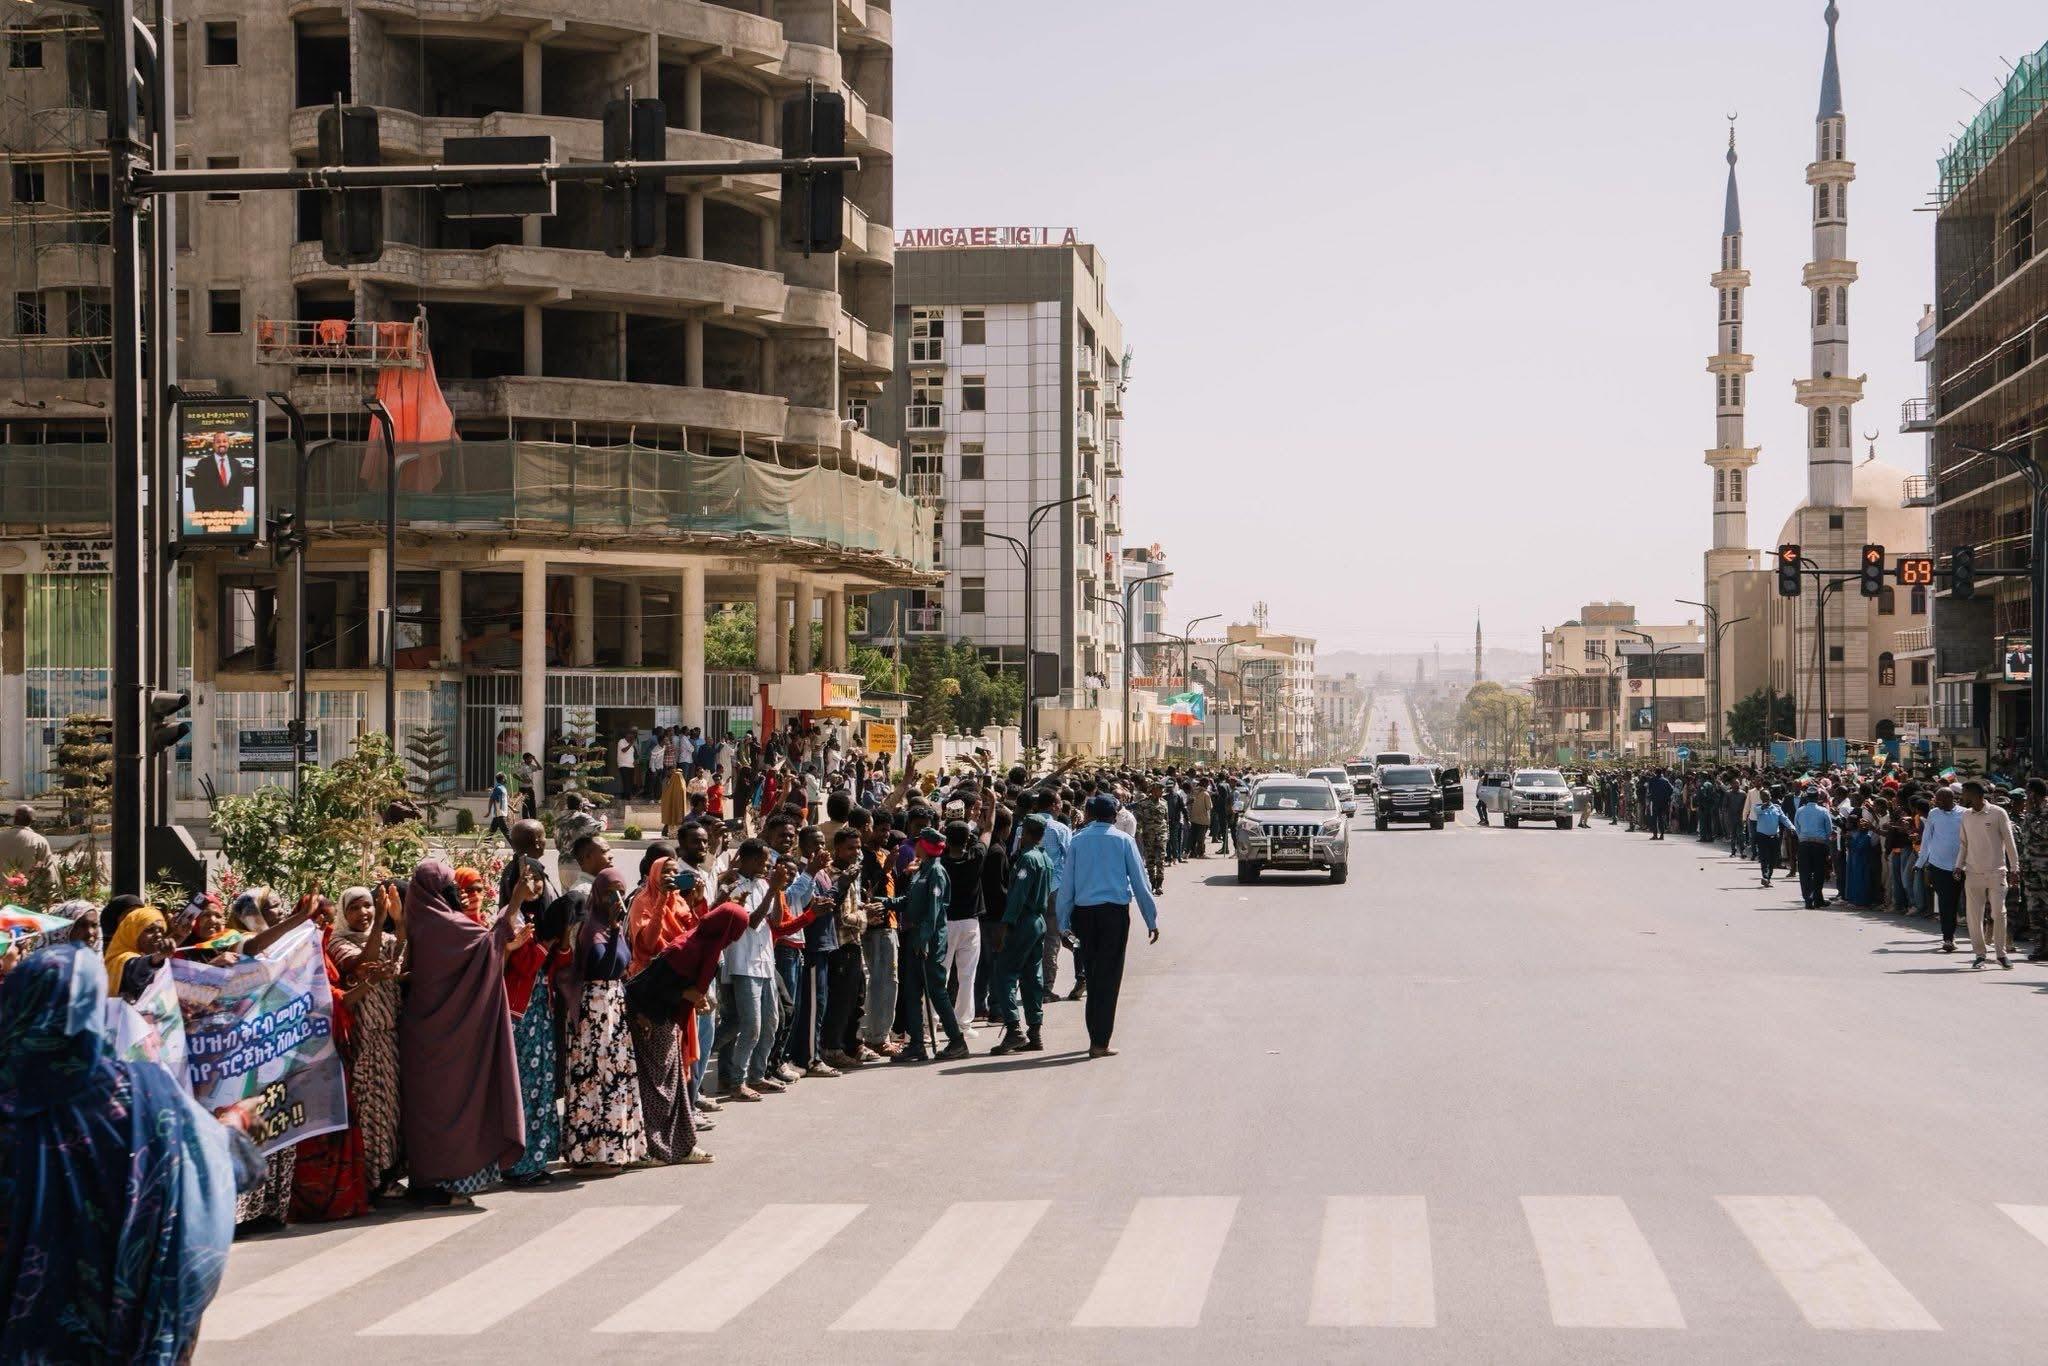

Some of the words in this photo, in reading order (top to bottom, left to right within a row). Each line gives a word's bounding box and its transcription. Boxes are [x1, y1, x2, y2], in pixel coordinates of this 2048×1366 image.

[78, 562, 109, 571] BANK
[1904, 561, 1931, 583] 69
[187, 1030, 236, 1055] ህዝብ
